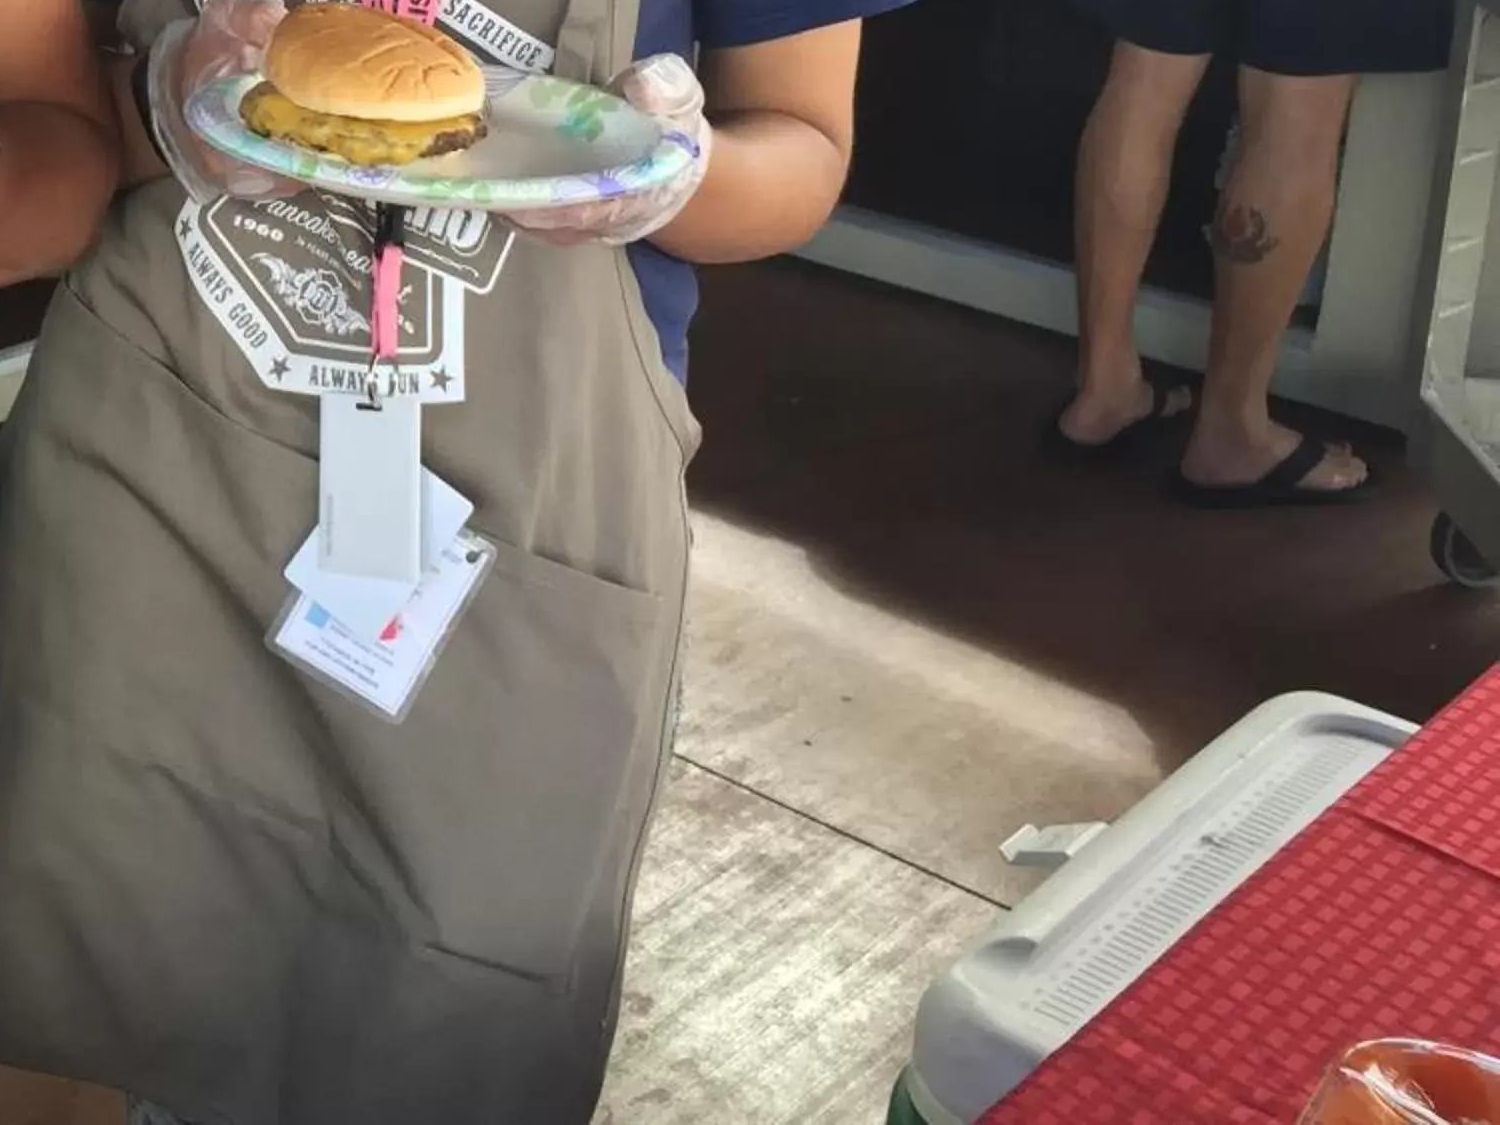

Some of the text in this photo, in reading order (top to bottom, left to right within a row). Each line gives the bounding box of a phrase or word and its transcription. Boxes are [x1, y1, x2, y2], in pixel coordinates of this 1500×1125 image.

[255, 199, 337, 244] ancake
[188, 242, 269, 349] ALWAYS GOOD
